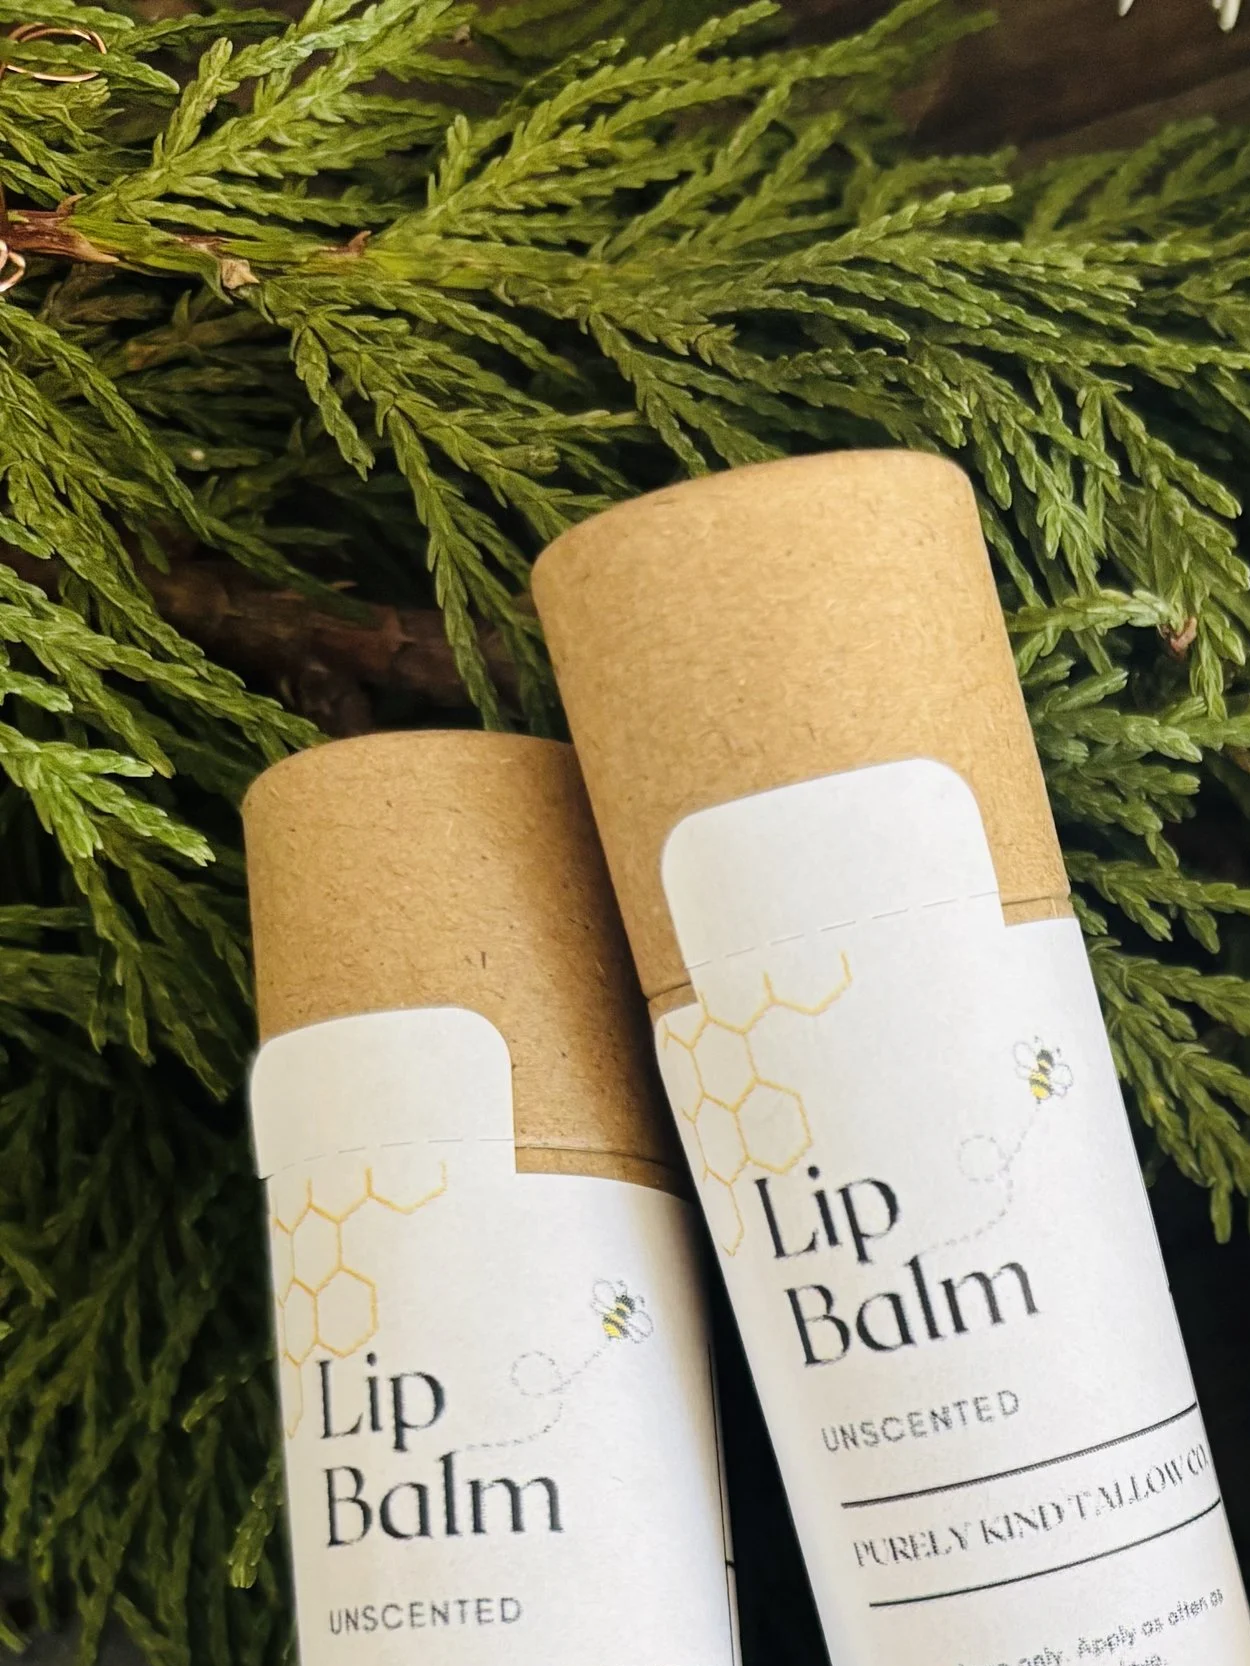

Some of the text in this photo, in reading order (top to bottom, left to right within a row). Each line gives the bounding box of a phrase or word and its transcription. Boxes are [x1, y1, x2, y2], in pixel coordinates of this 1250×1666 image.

[753, 1165, 901, 1265] Lip
[783, 1254, 1040, 1368] Balm
[317, 1351, 446, 1452] Lip
[821, 1388, 1021, 1453] UNSCENTED
[323, 1450, 565, 1549] Balm
[852, 1522, 973, 1568] PURELY
[980, 1501, 1065, 1544] KIND
[1066, 1460, 1188, 1523] TALLOW
[329, 1596, 523, 1636] UNSCENTED
[1076, 1625, 1137, 1659] Apply
[1141, 1617, 1165, 1638] as
[1166, 1597, 1210, 1629] often
